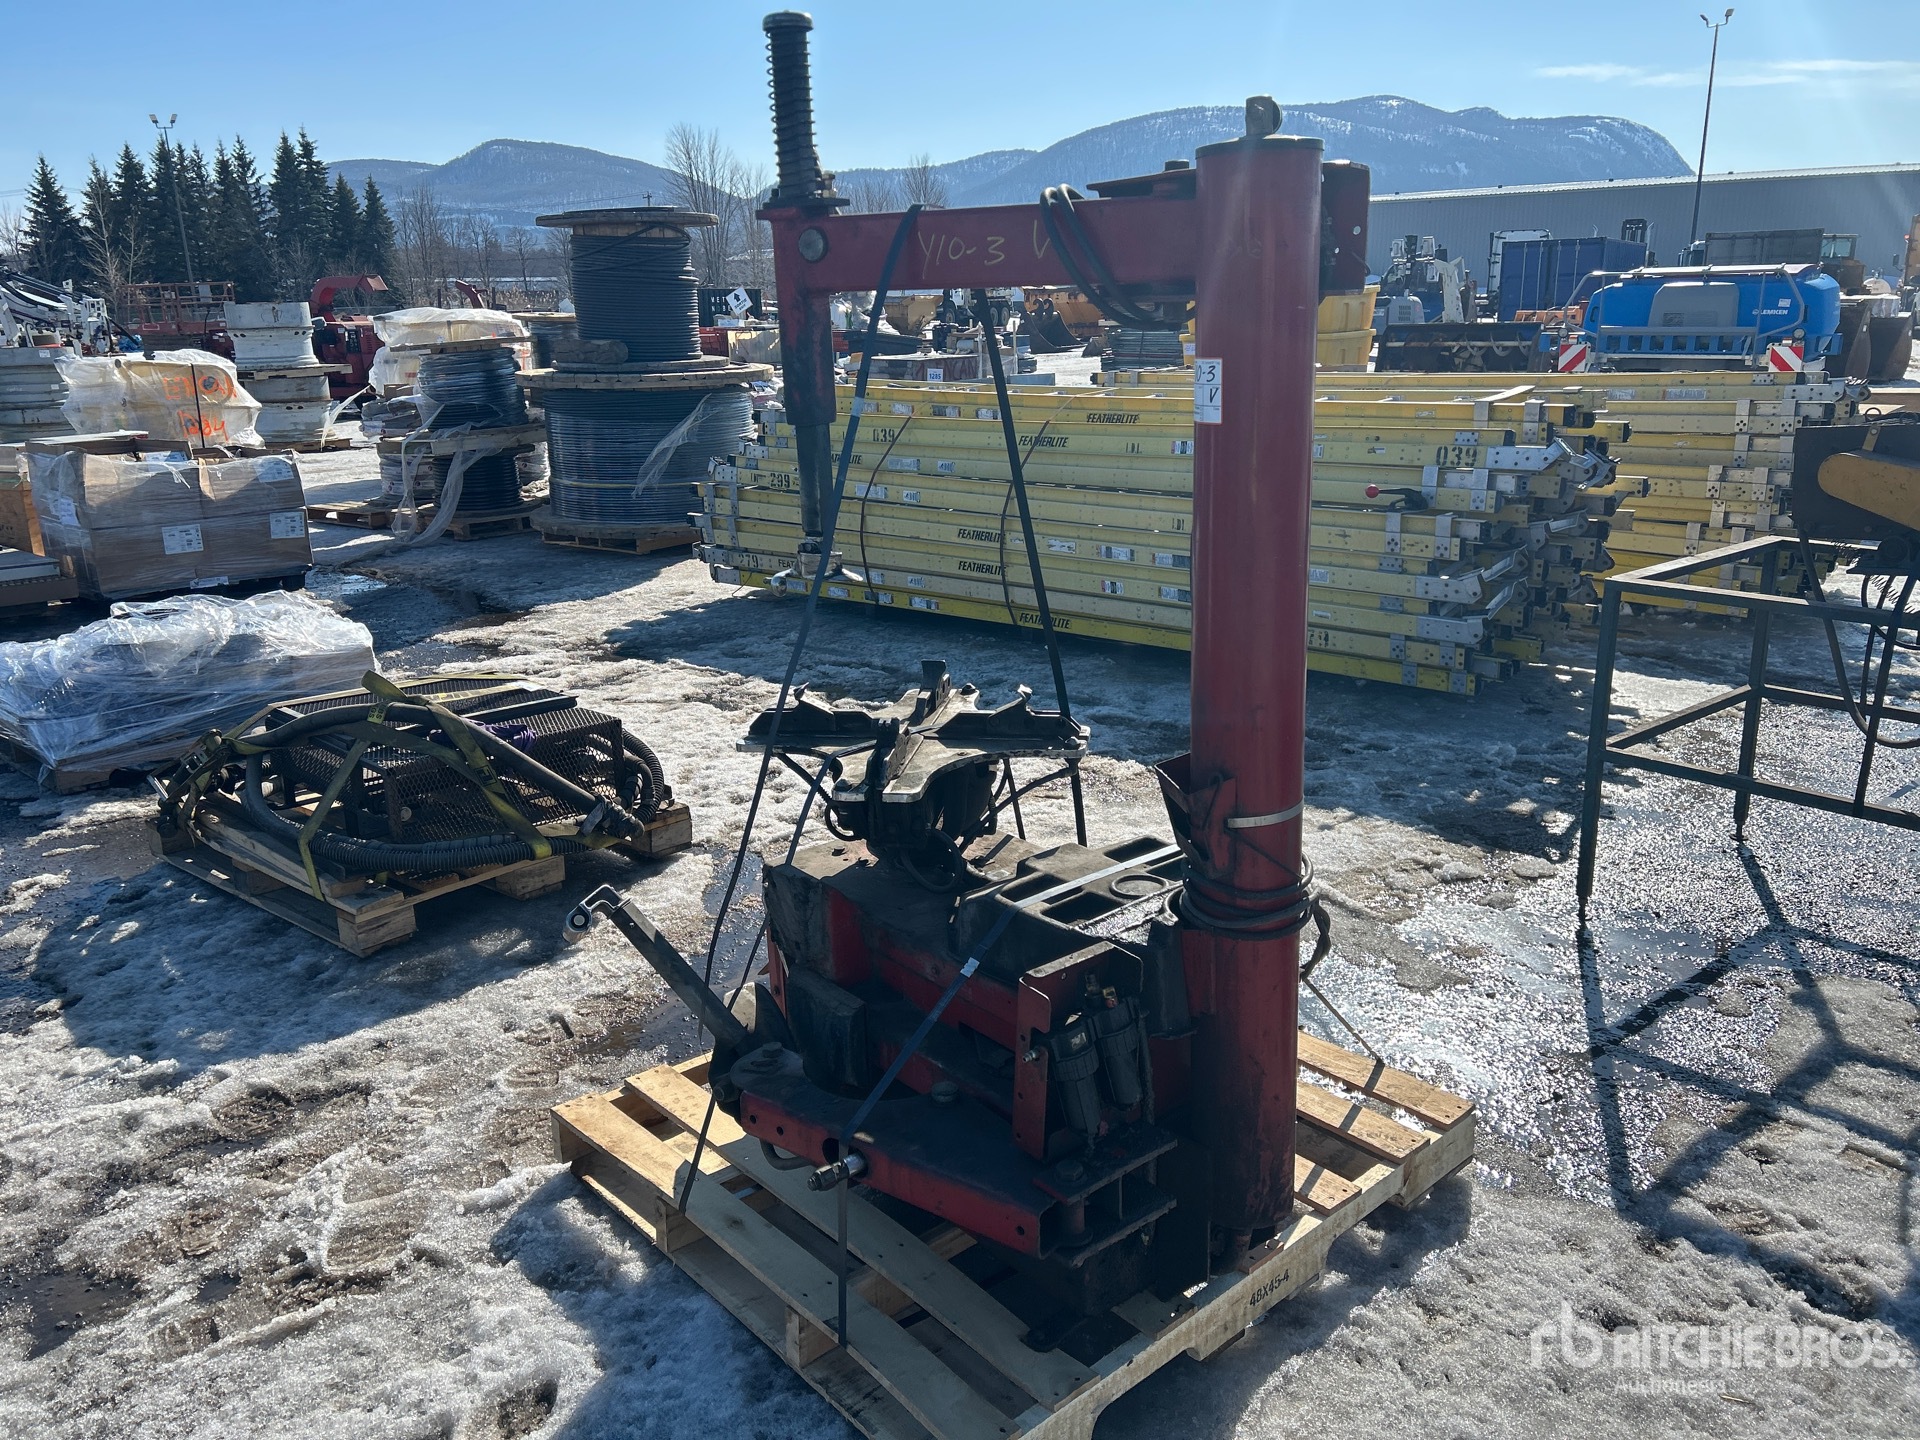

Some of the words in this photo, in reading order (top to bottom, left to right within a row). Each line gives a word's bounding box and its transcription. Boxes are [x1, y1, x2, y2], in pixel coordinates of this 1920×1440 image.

[1194, 364, 1217, 383] 0-3
[1086, 412, 1140, 425] FEATHERLITE
[1018, 434, 1070, 449] FEATHERLITE
[1435, 445, 1478, 467] 039
[1019, 611, 1072, 630] FEATLITE
[1249, 1268, 1290, 1307] 48X45-4
